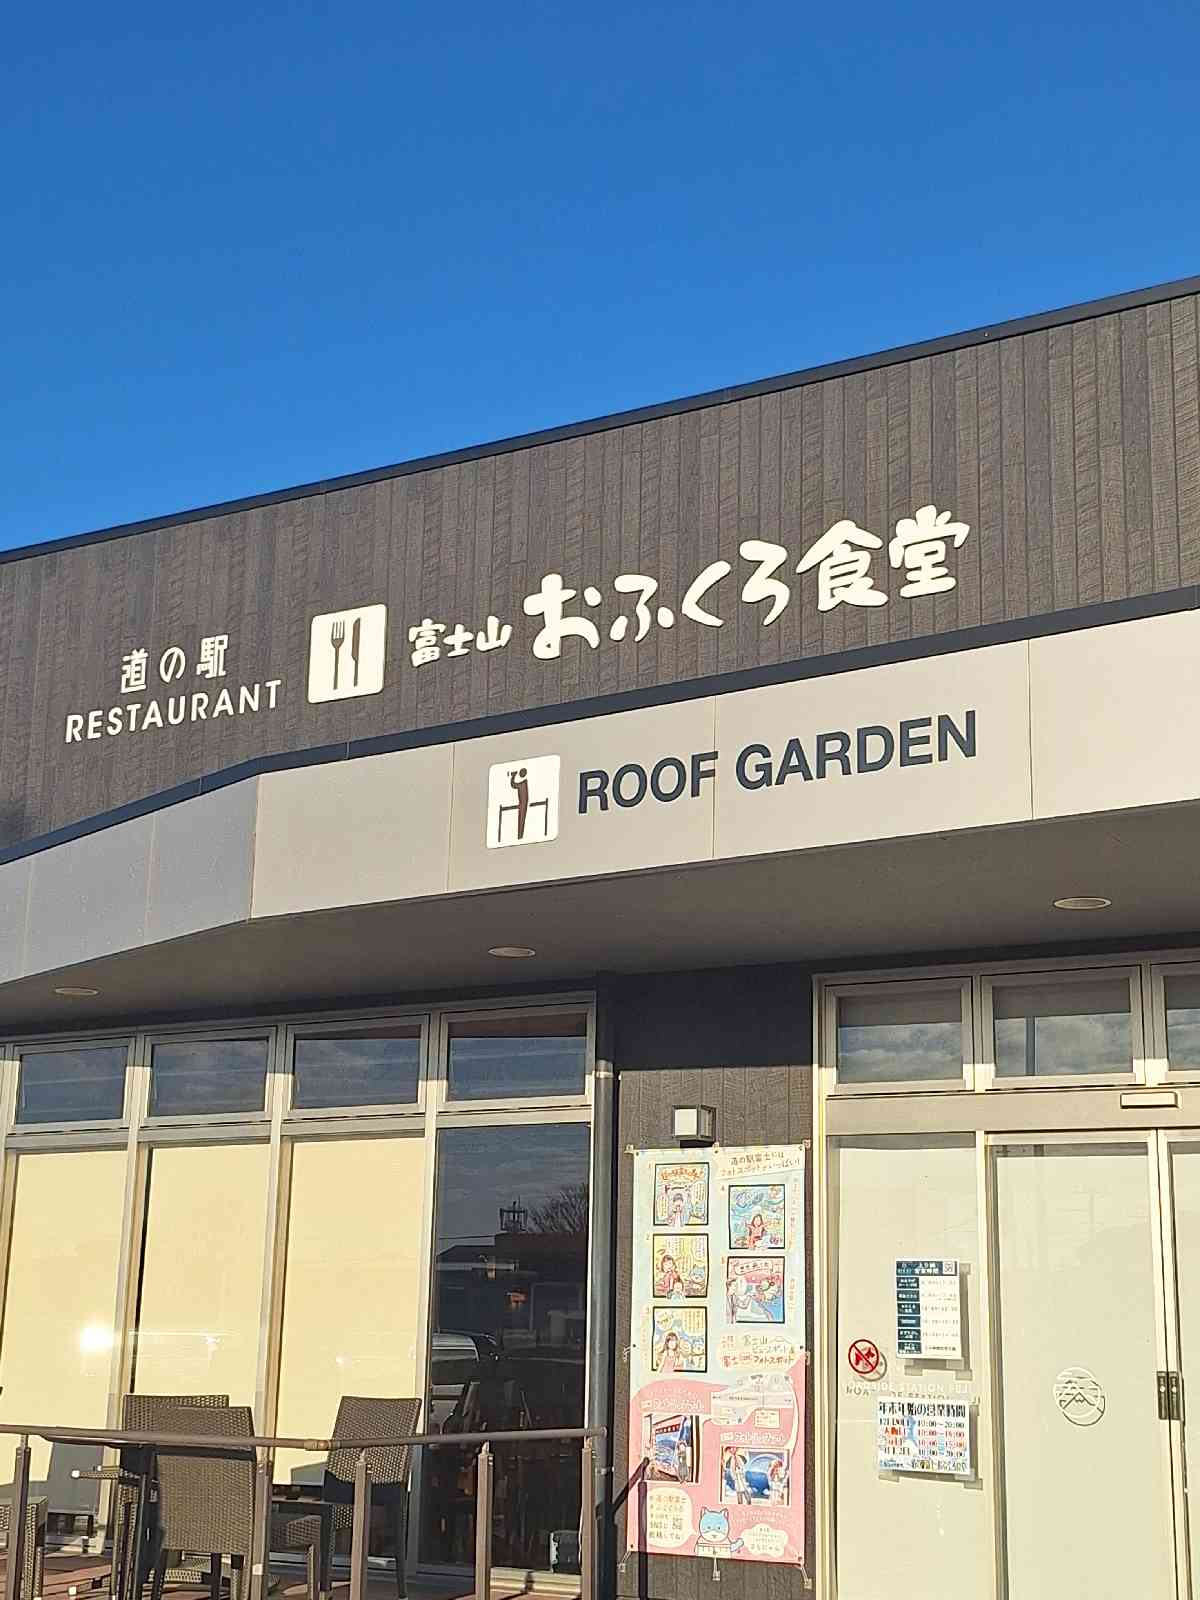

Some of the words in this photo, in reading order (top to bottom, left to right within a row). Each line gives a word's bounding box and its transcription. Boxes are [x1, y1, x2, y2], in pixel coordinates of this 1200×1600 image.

[408, 618, 513, 668] 富士山
[523, 504, 971, 660] おふくろ食堂
[120, 634, 229, 694] 道の駅
[64, 679, 282, 743] RESTAURANT
[577, 751, 719, 815] ROOF
[735, 709, 977, 790] GARDEN
